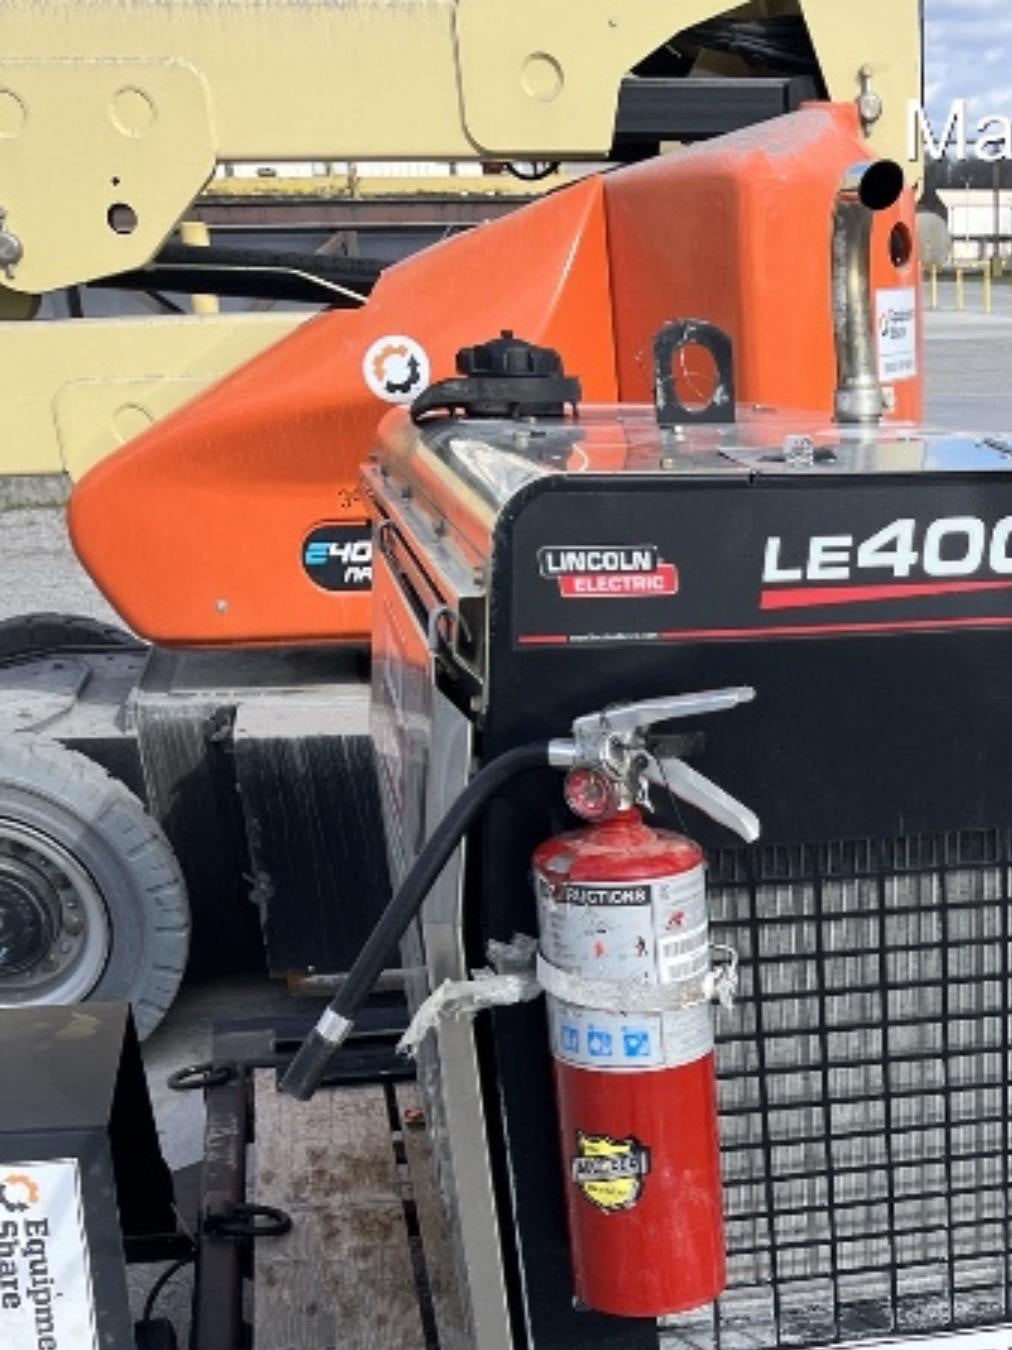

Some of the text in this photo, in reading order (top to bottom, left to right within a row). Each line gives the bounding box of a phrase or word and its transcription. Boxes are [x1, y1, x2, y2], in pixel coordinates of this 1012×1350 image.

[546, 551, 652, 573] LINCOLN
[574, 575, 665, 593] ELECTRIC
[0, 1219, 21, 1310] Share
